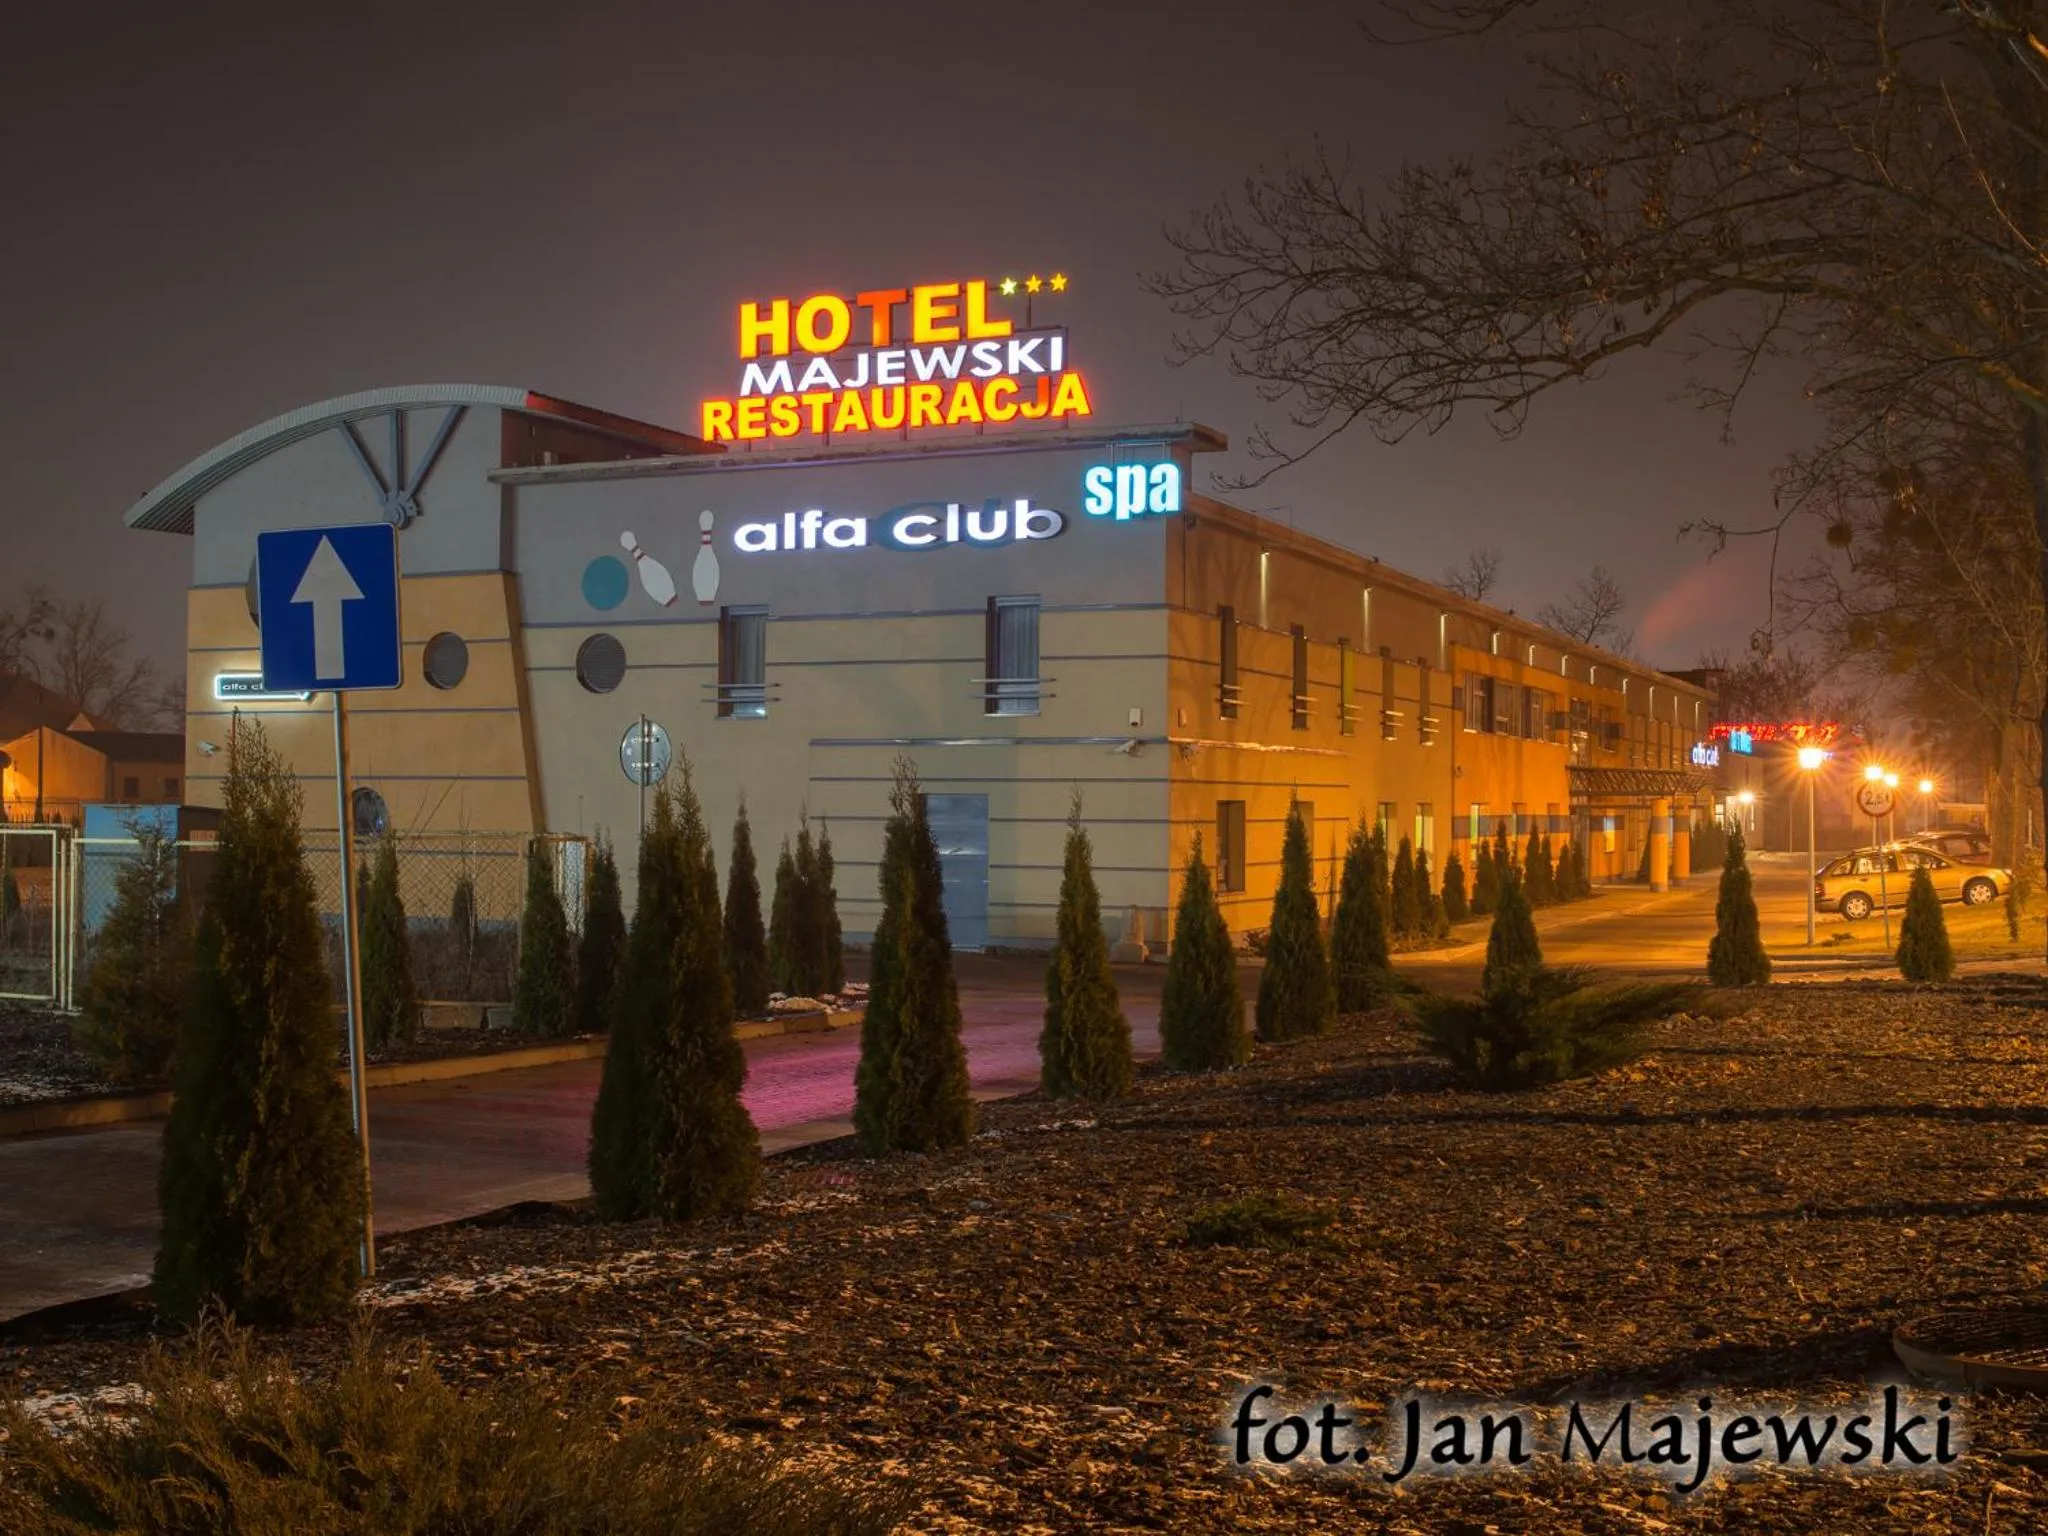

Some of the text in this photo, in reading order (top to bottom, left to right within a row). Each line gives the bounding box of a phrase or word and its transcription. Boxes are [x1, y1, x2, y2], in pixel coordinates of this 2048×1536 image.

[740, 279, 1013, 359] HOTEL
[740, 336, 1063, 397] MAJEWSKI
[702, 371, 1092, 442] RESTAURACJA
[1085, 462, 1180, 520] spa
[734, 499, 1063, 552] alfa club
